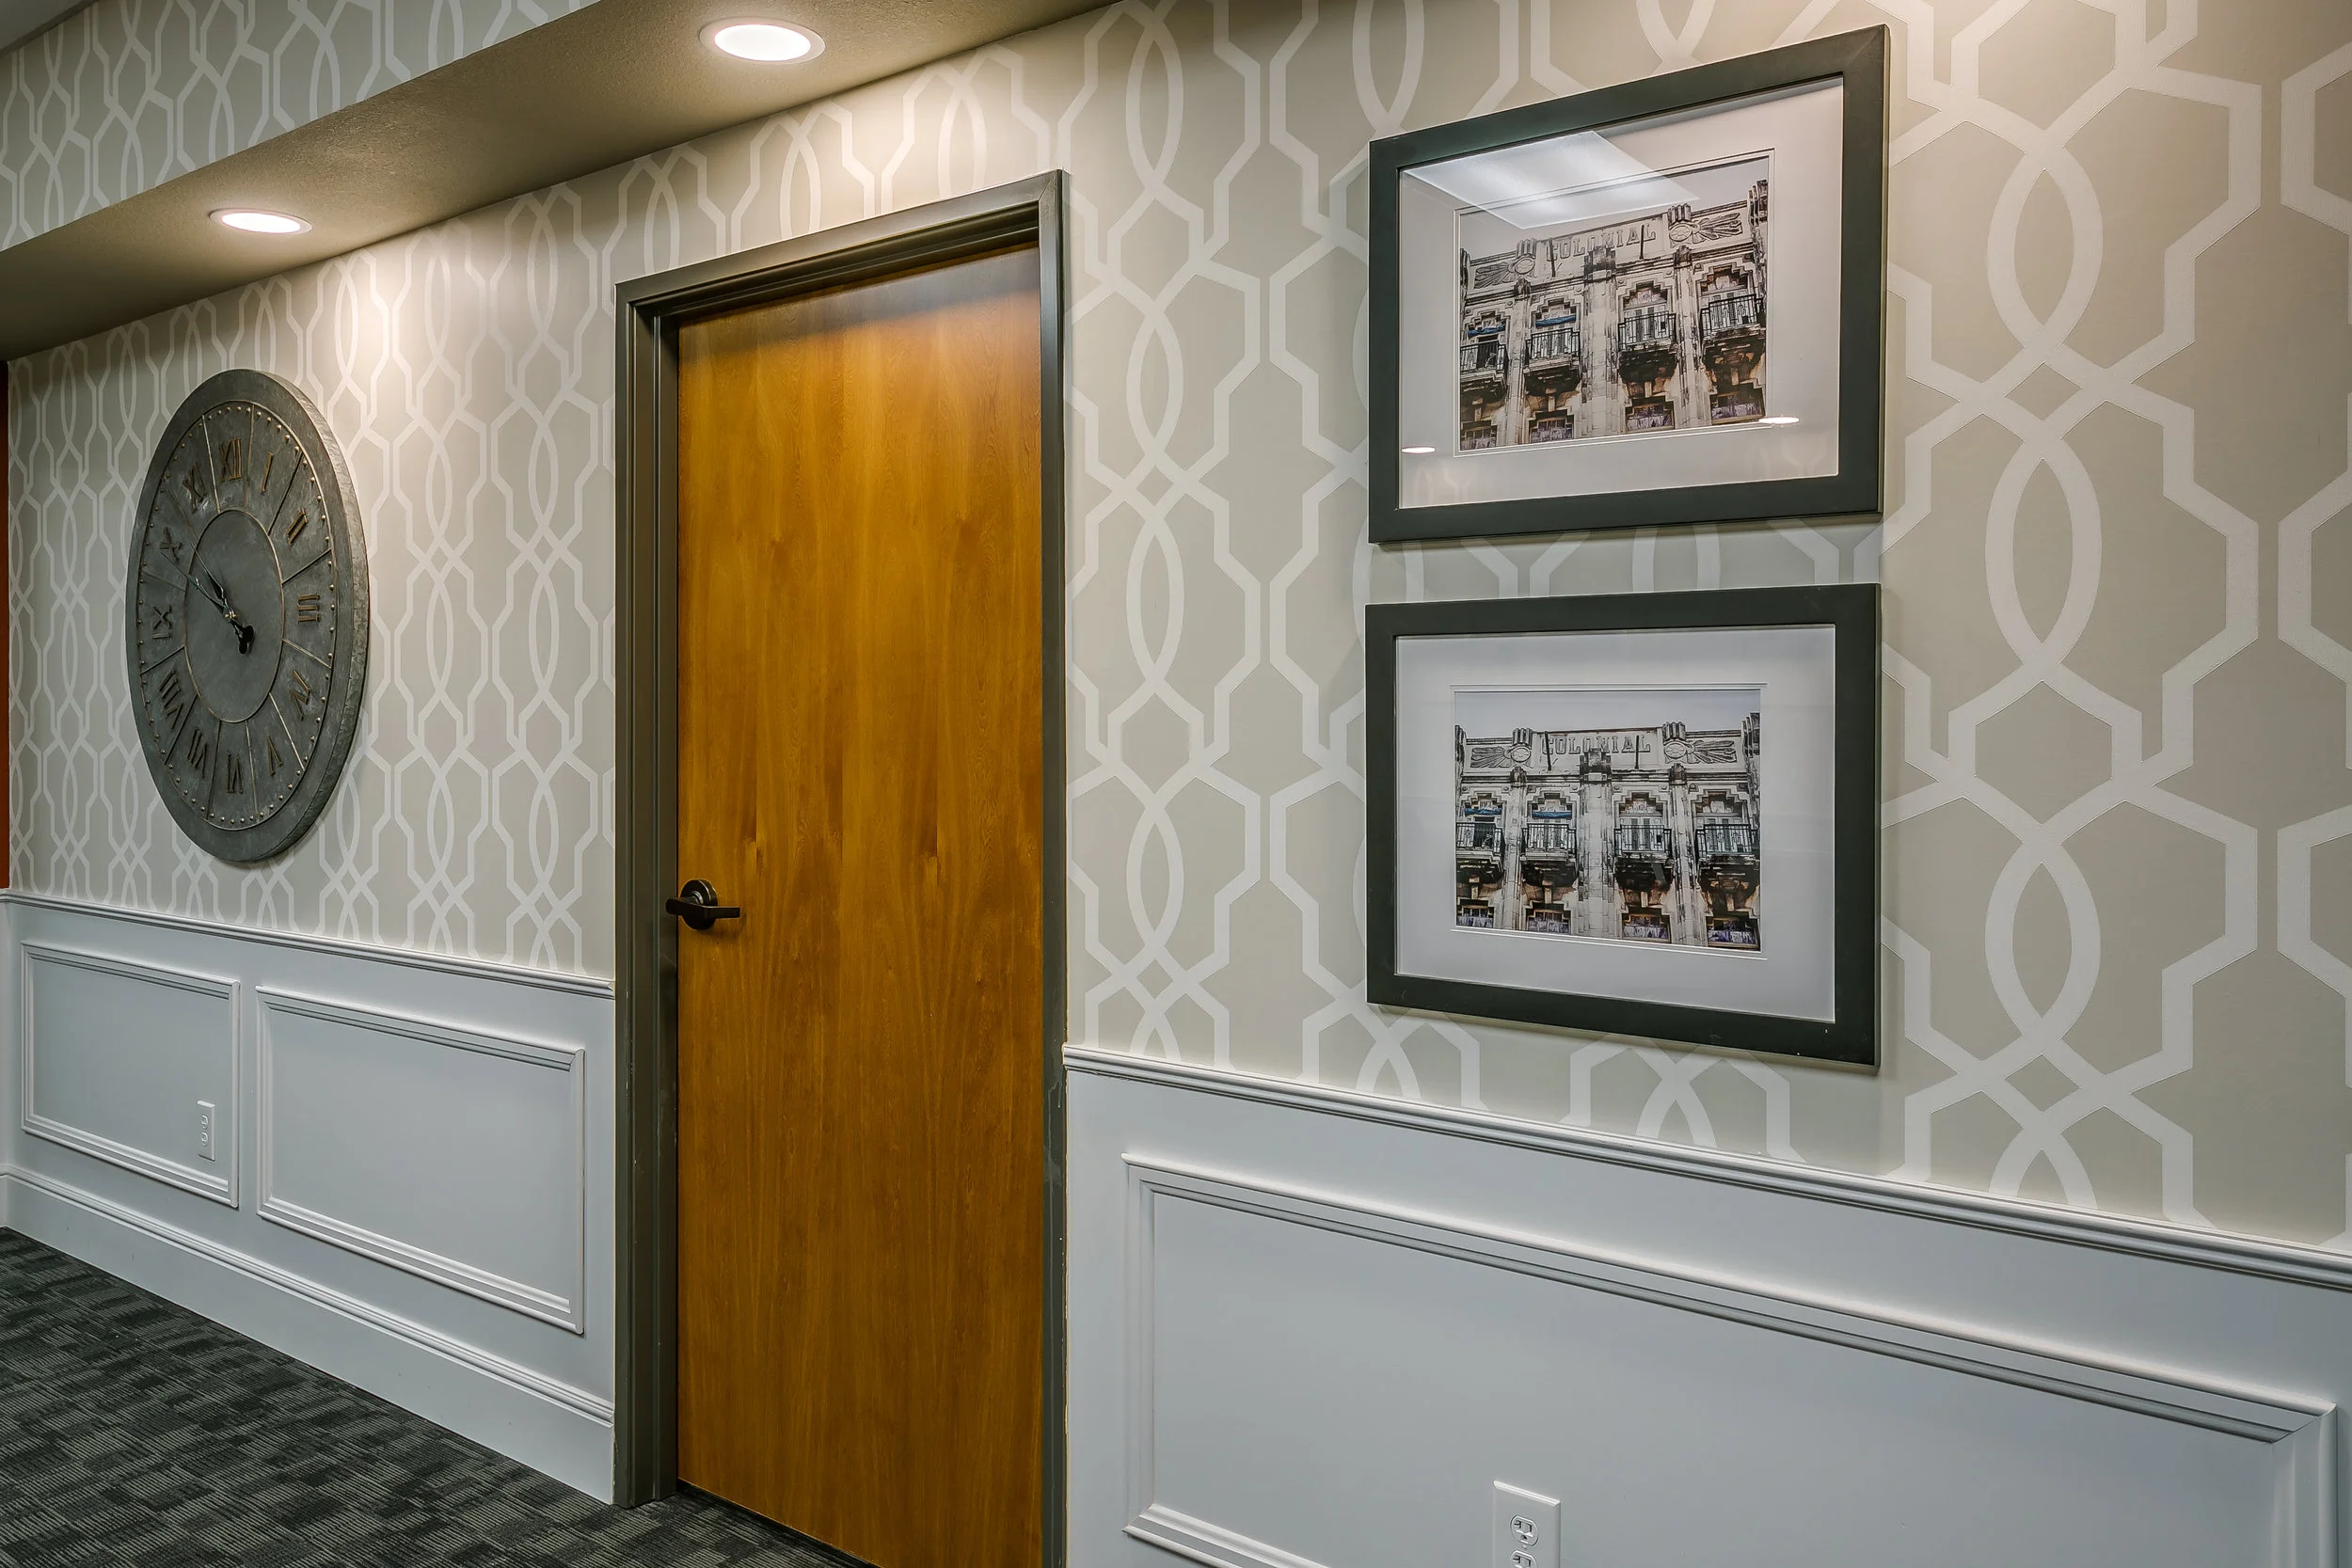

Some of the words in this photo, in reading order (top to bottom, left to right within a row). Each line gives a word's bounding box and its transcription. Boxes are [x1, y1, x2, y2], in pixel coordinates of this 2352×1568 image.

[1546, 222, 1657, 262] COLONIAL
[219, 437, 242, 483] XII
[260, 451, 274, 494] I
[182, 462, 208, 514] XI
[159, 526, 183, 562] X
[285, 506, 309, 546] II
[151, 605, 173, 640] IX
[297, 592, 321, 624] III
[289, 669, 310, 721] IV
[188, 728, 208, 780] VII
[266, 735, 283, 776] V
[1542, 735, 1651, 755] COLONIAL
[226, 752, 244, 795] VI
